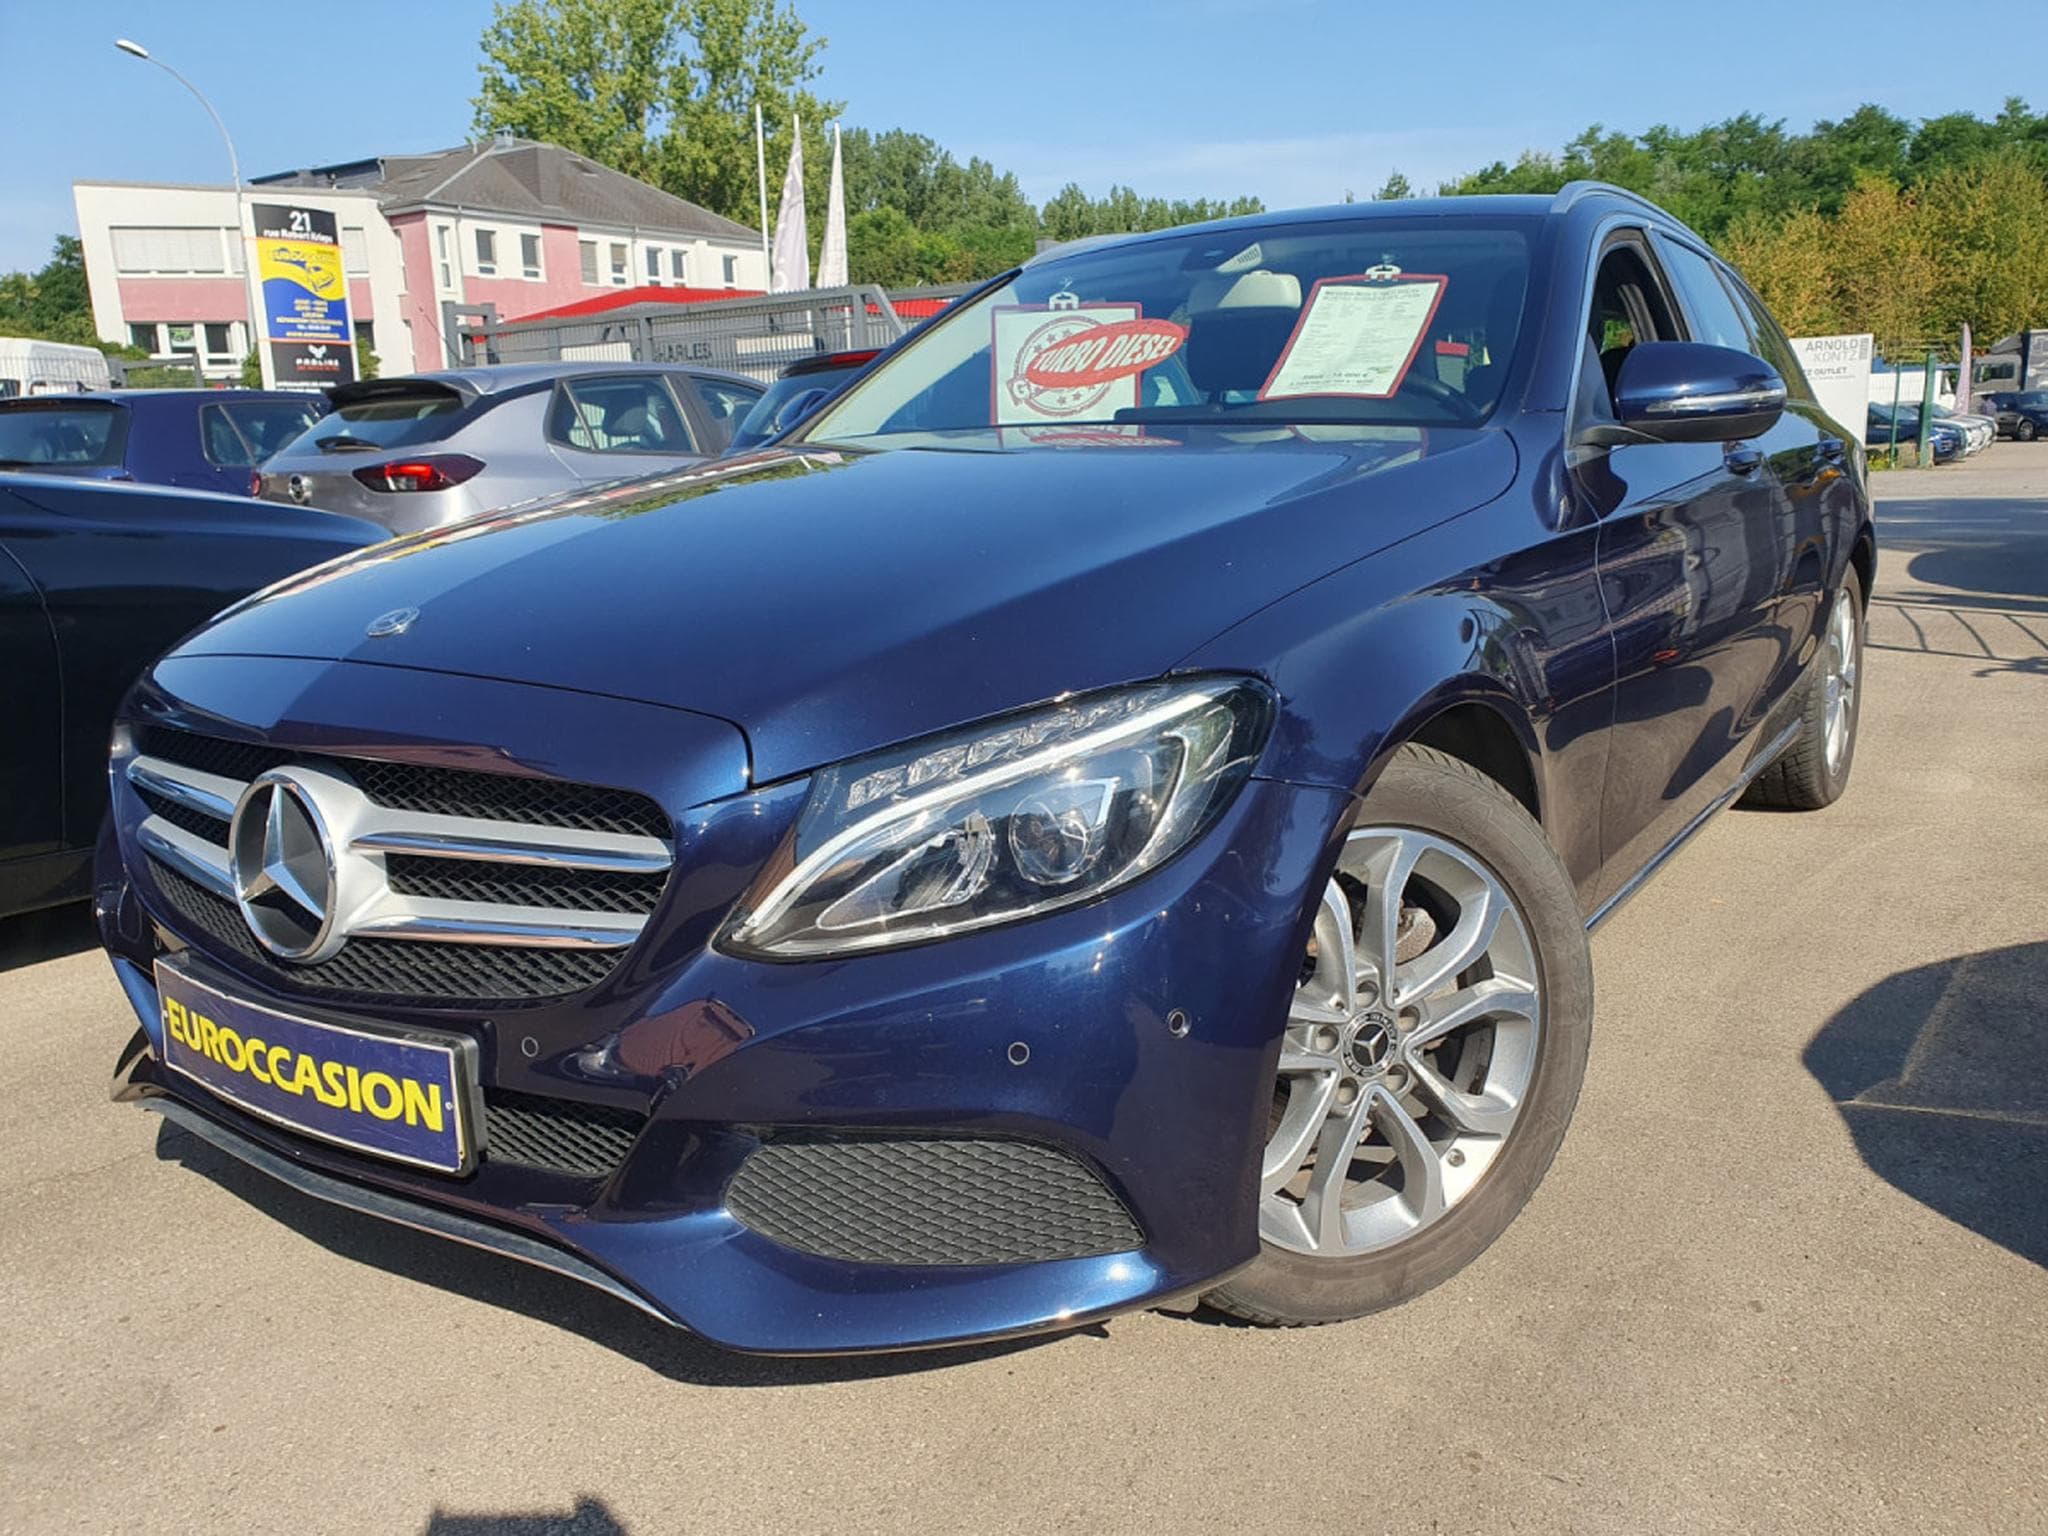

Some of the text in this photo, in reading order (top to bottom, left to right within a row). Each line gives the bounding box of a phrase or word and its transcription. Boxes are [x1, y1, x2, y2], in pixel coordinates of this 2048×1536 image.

[289, 210, 312, 232] 21
[1033, 333, 1177, 373] TURBO DIESEL
[1806, 339, 1858, 351] ARNOLD
[1813, 350, 1858, 362] KONTZ
[1814, 367, 1847, 375] OUTLET
[165, 996, 444, 1132] EUROCCASION
